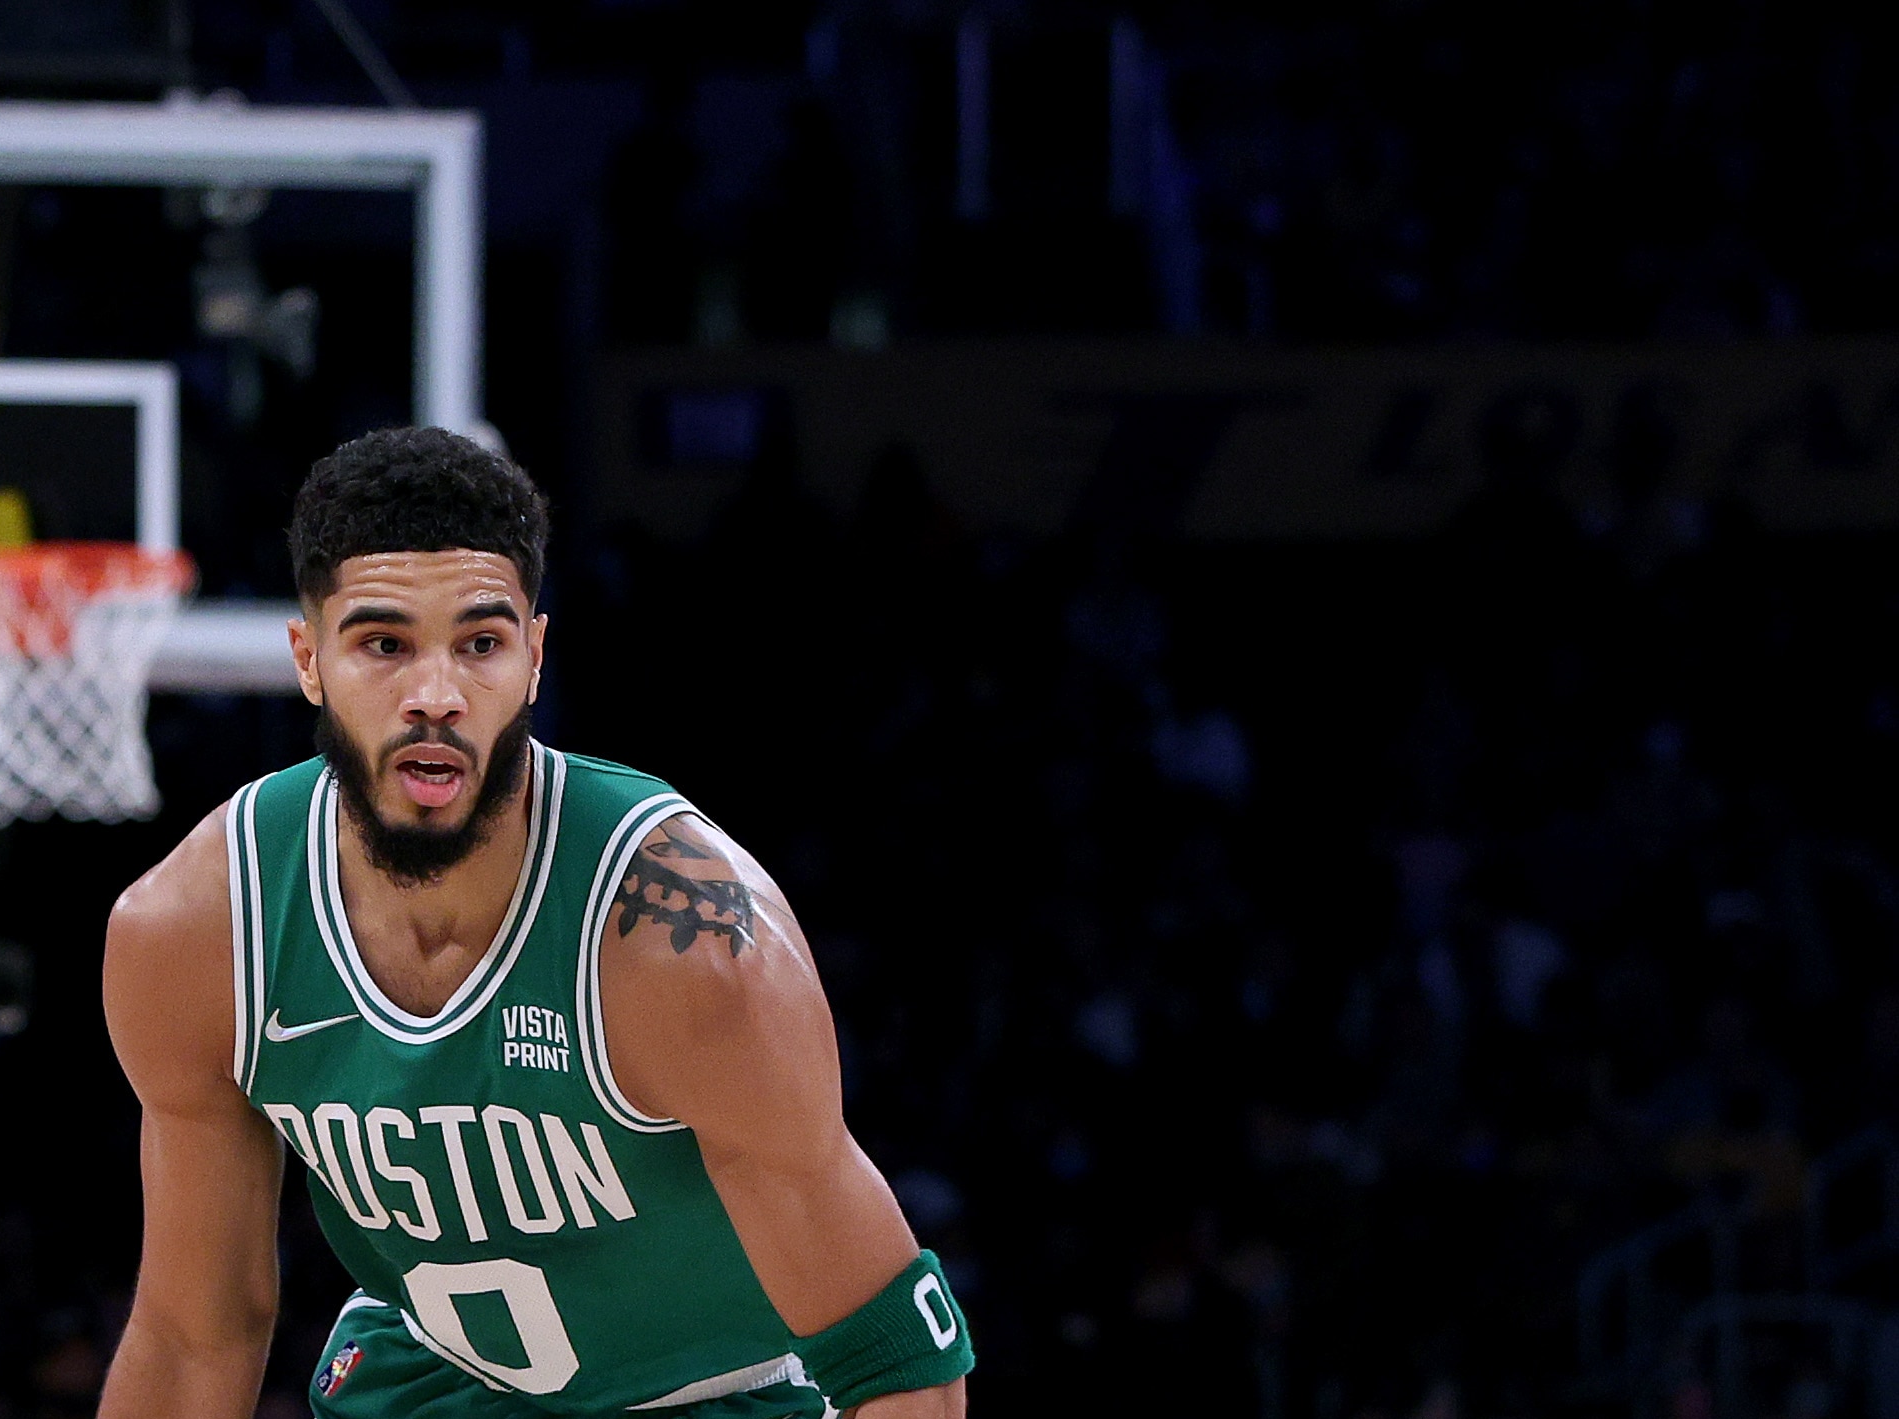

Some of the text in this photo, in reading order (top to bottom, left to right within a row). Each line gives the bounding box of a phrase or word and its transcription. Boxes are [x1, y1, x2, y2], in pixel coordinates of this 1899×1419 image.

[502, 1005, 569, 1048] VISTA
[503, 1041, 571, 1074] PRINT
[262, 1102, 638, 1244] BOSTON
[402, 1257, 581, 1396] 0
[913, 1271, 958, 1351] 0
